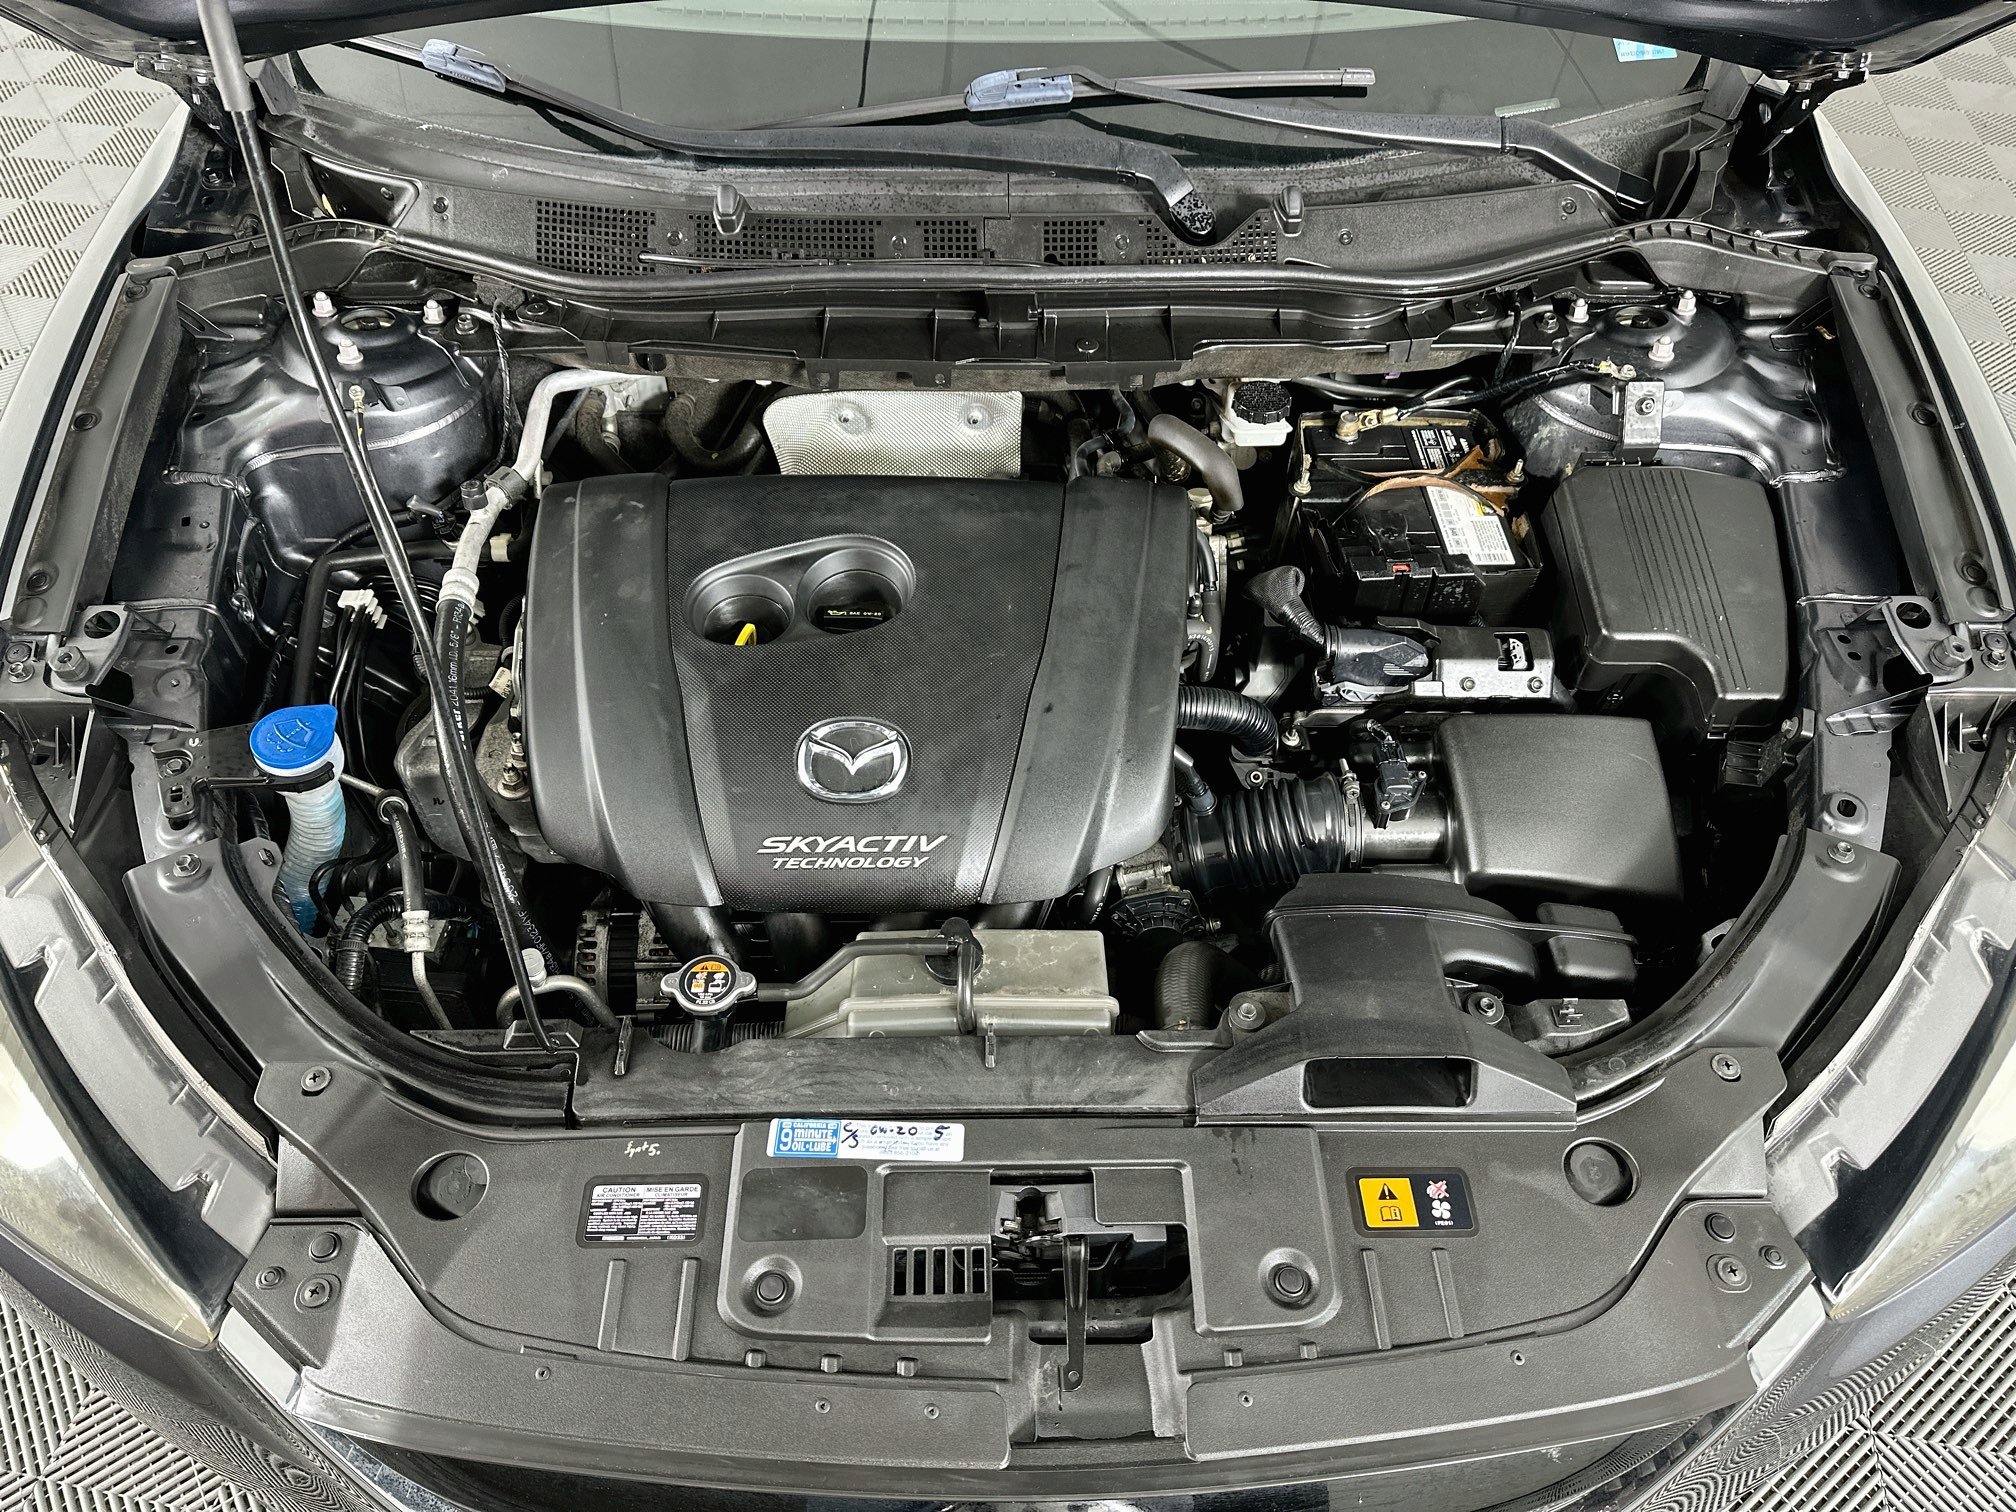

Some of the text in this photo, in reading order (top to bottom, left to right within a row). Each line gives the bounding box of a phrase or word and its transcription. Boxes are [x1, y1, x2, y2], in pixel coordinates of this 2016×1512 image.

[756, 835, 948, 854] SKYACTIV
[773, 856, 930, 869] TECHNOLOGY
[779, 1128, 793, 1151] 9
